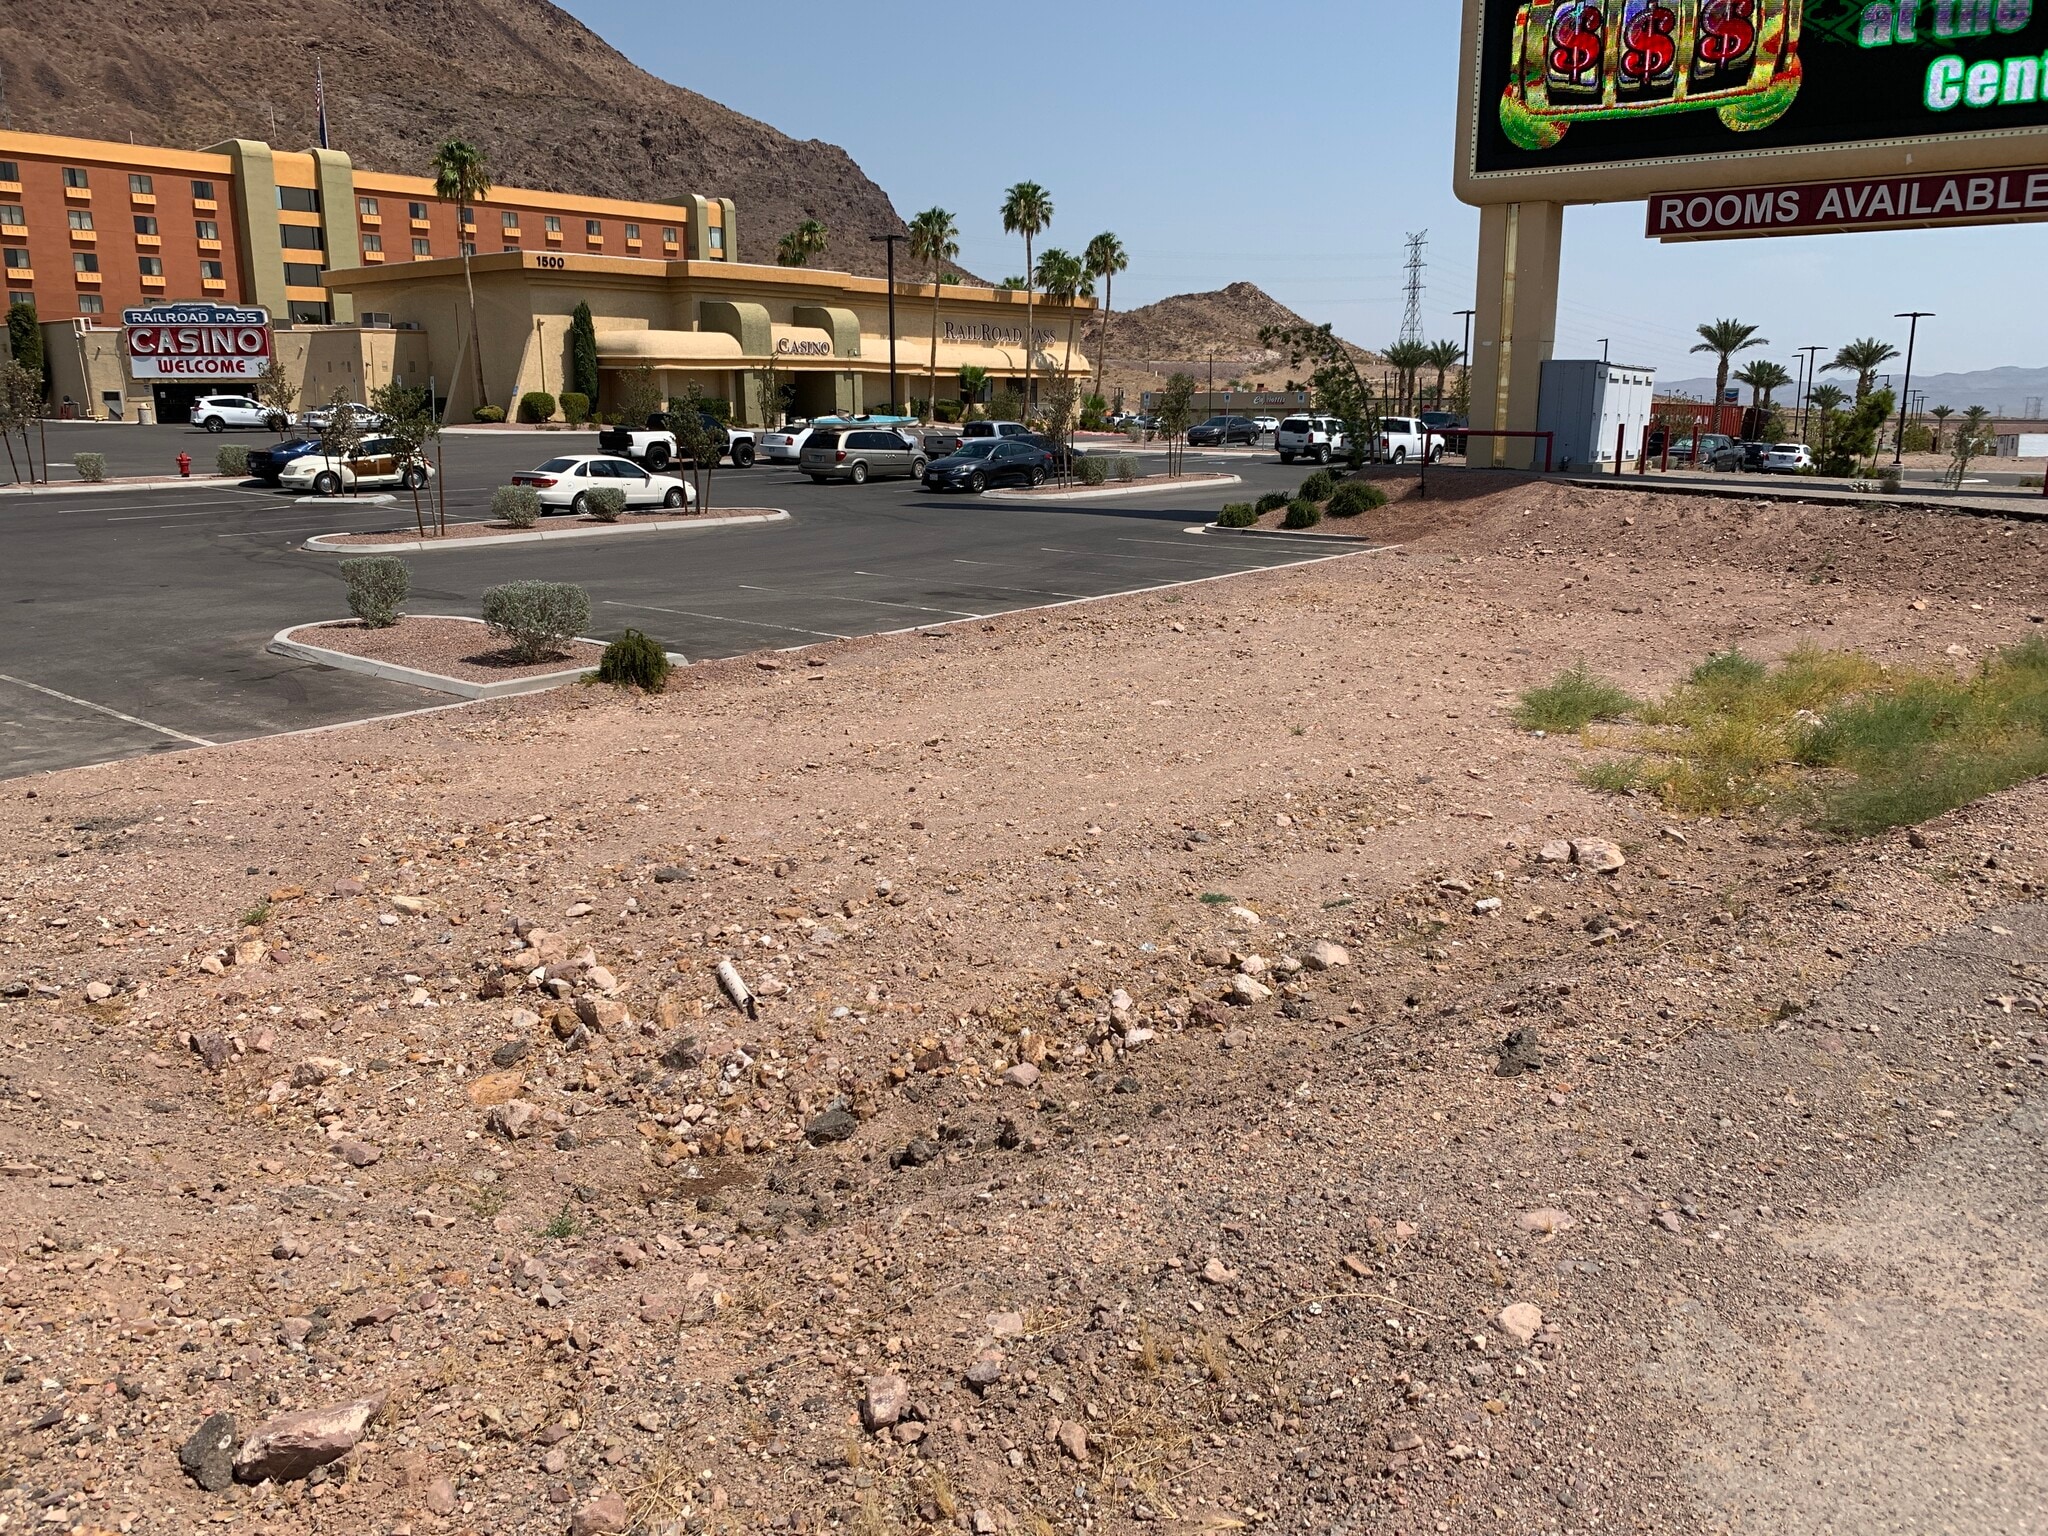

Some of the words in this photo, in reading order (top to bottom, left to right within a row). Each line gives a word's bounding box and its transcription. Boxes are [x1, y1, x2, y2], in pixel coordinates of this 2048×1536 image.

[1659, 190, 1800, 230] ROOMS
[1815, 173, 2048, 220] AVAILABLE
[536, 255, 565, 269] 1500
[132, 312, 209, 323] RAILROAD
[215, 312, 258, 323] PASS
[131, 327, 264, 354] CASINO
[778, 337, 830, 356] CASINO
[157, 359, 246, 373] WELCOME
